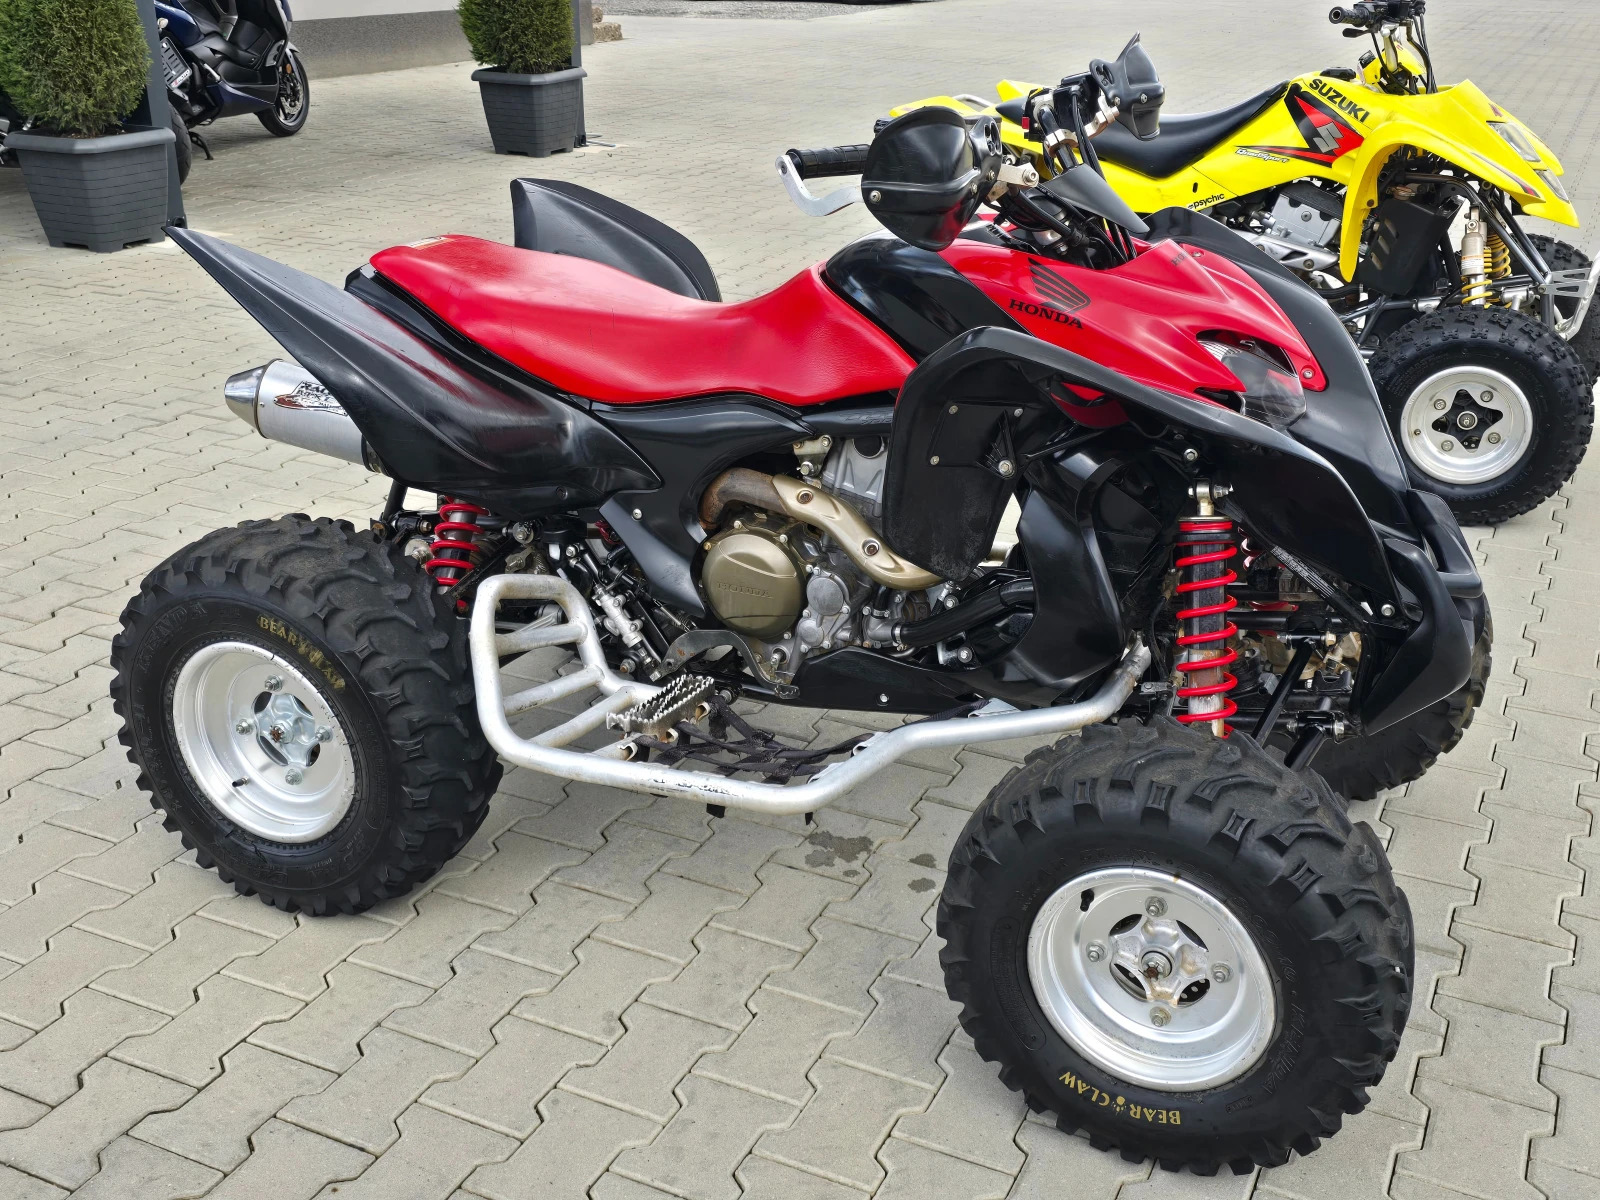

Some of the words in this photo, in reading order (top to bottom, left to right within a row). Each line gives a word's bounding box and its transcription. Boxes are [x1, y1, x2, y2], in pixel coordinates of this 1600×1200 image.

[1309, 78, 1370, 123] SUZUKI
[1193, 193, 1225, 209] psychic
[1009, 298, 1084, 329] HONDA
[717, 581, 775, 599] HONDA
[257, 613, 298, 647] BEAR
[1059, 1071, 1111, 1107] CLAW
[1129, 1102, 1182, 1125] BEAR
